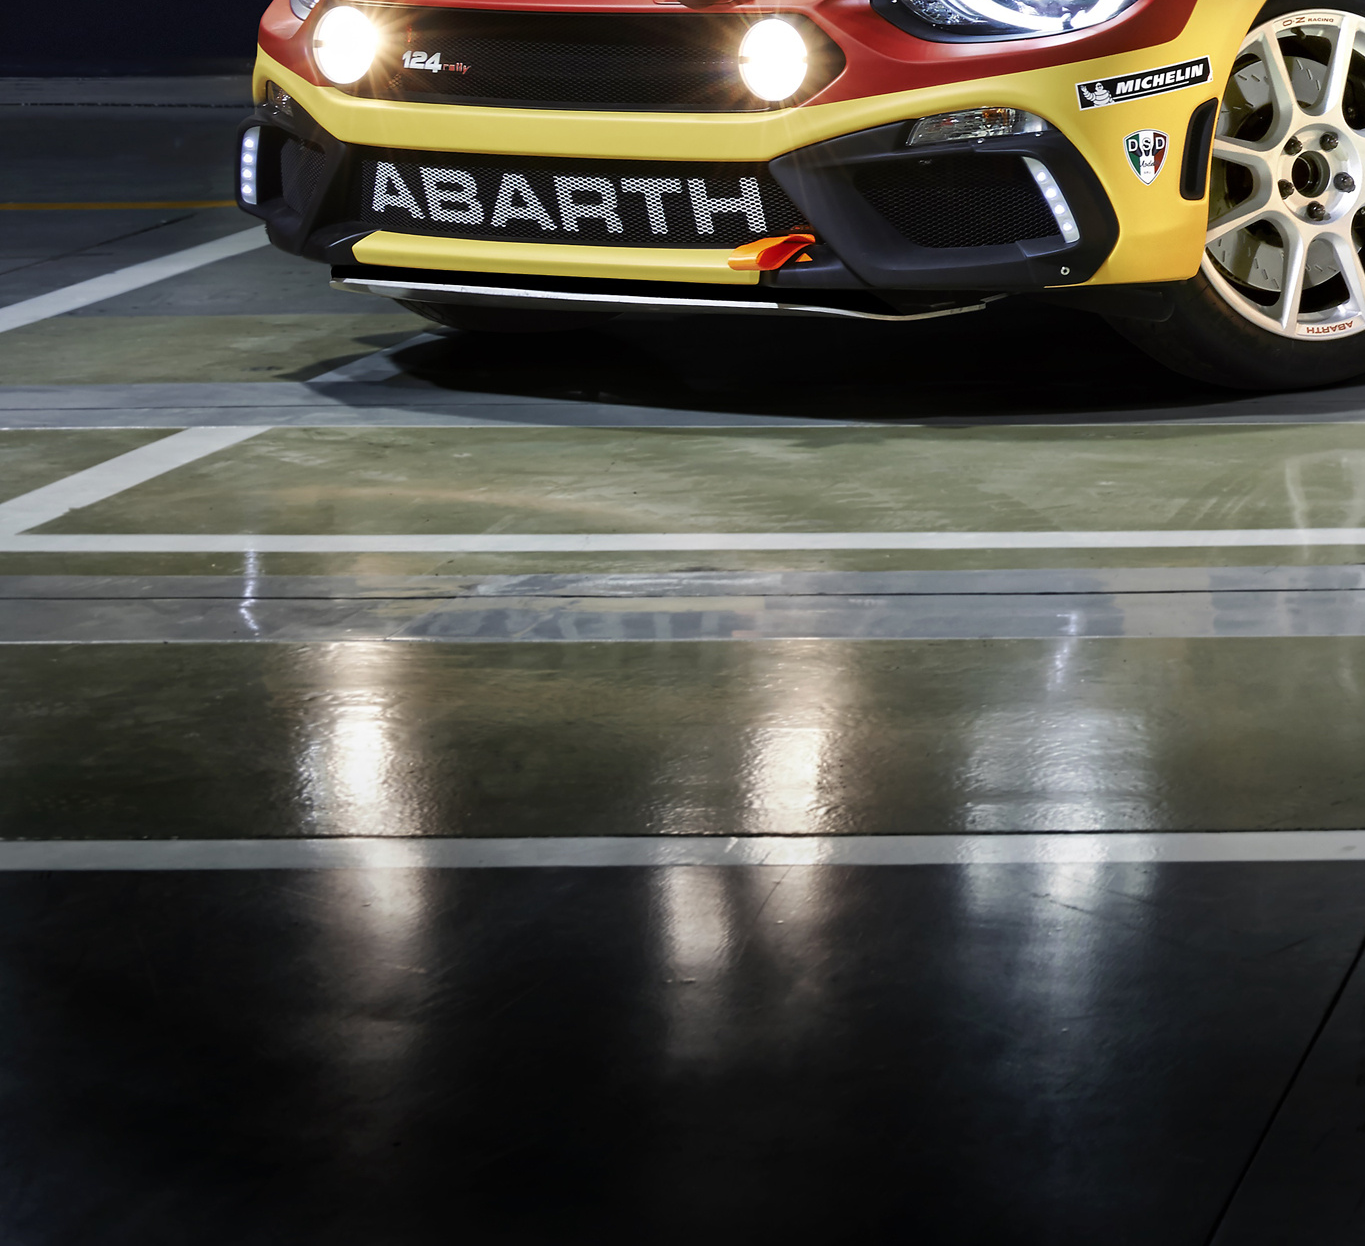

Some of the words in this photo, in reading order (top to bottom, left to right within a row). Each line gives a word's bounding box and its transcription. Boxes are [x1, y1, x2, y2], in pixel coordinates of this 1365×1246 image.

[402, 50, 442, 73] 124
[1115, 63, 1204, 95] MICHELIN
[1128, 136, 1165, 152] DSD
[371, 160, 769, 235] ABARTH
[1306, 320, 1353, 334] ABARTH
